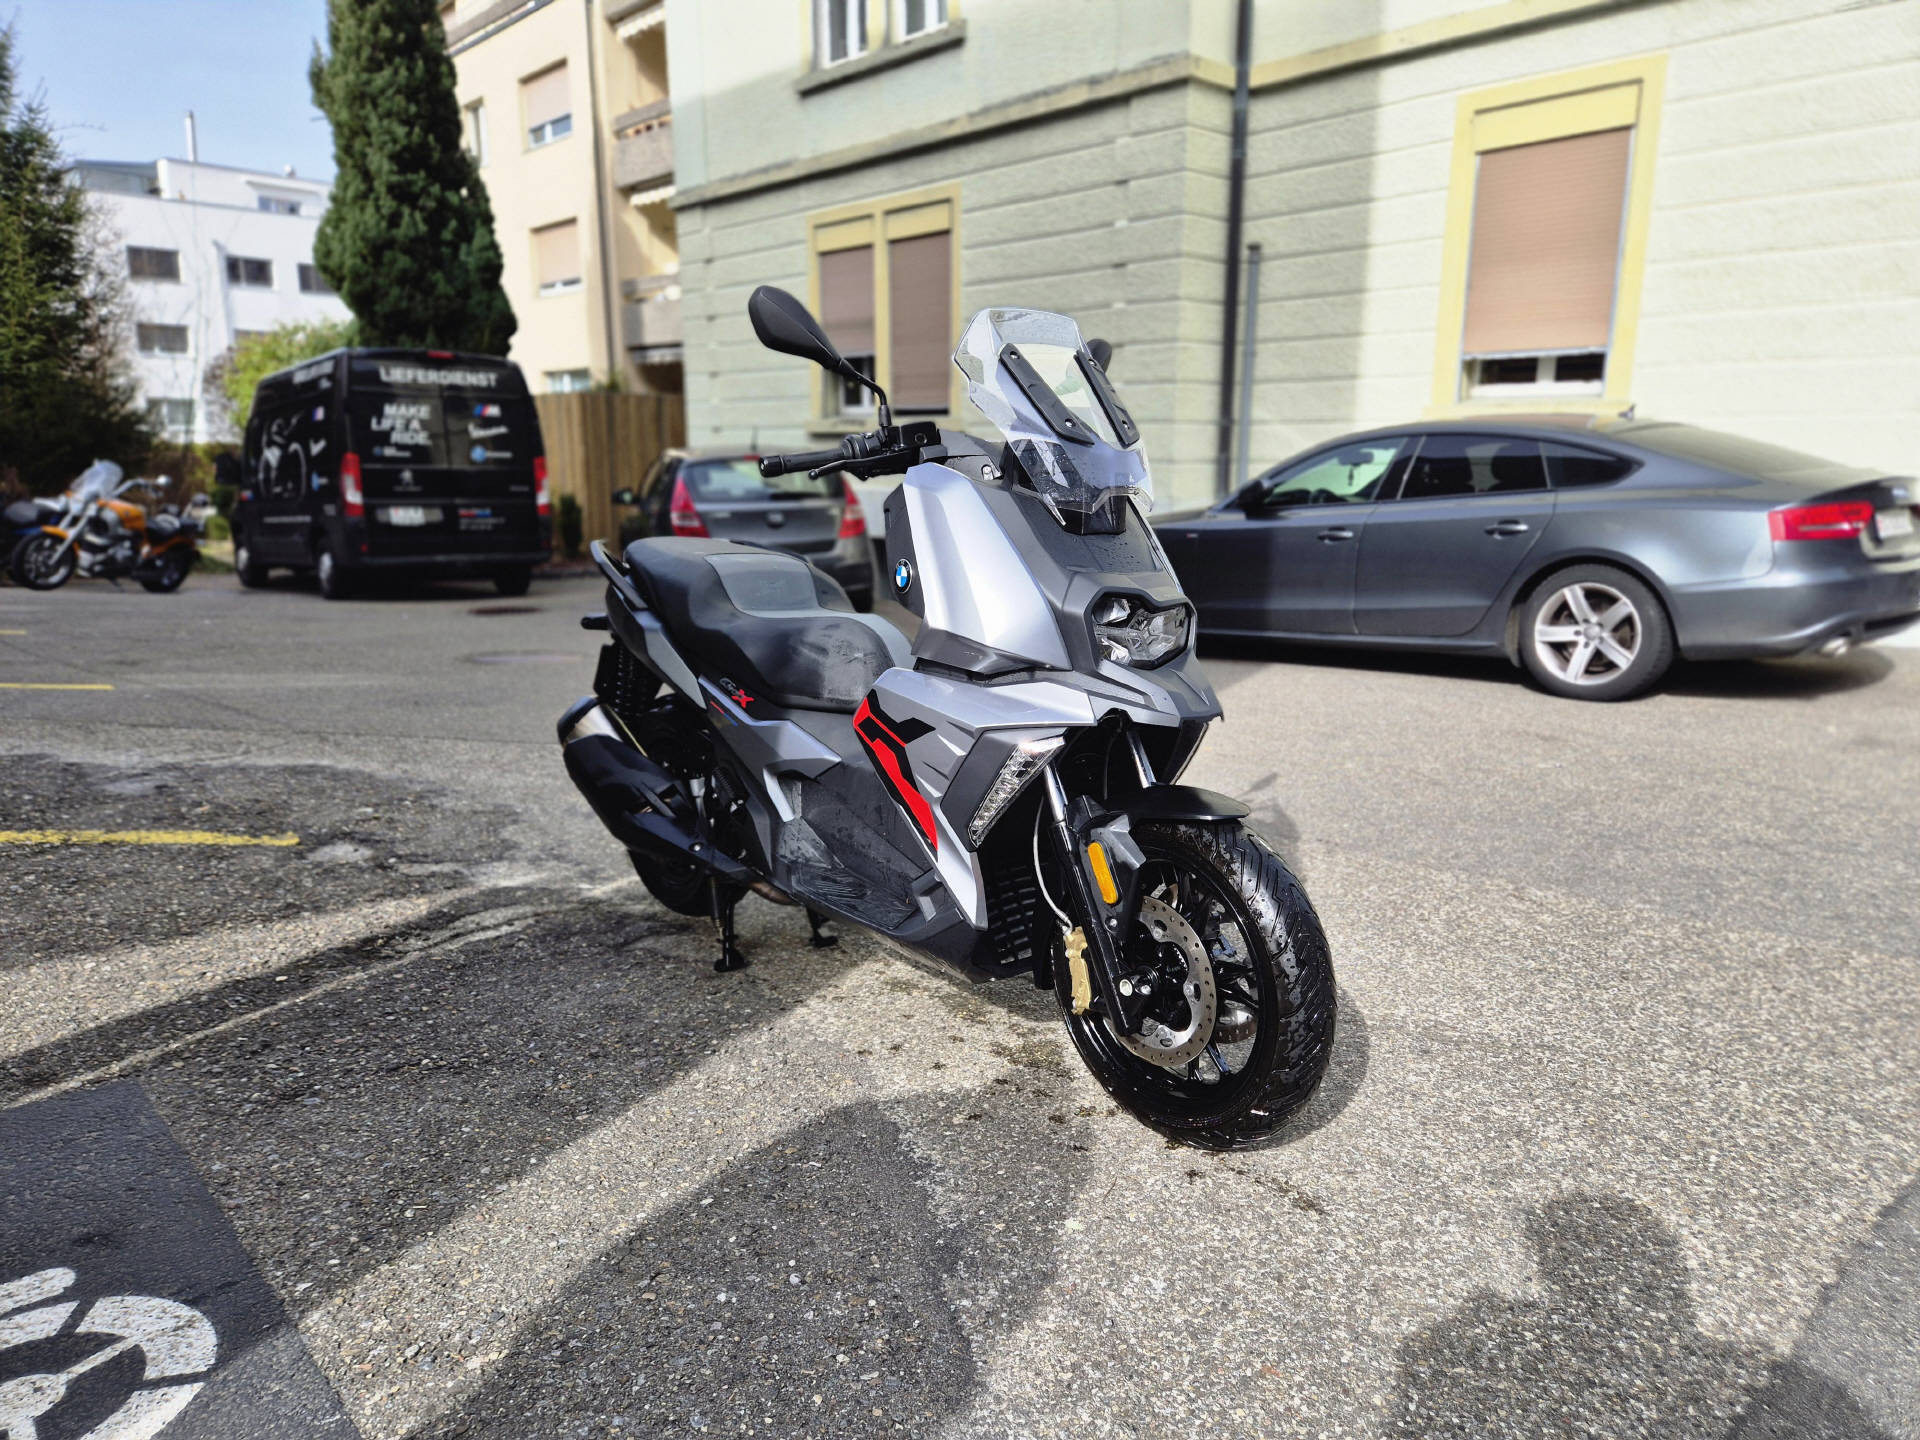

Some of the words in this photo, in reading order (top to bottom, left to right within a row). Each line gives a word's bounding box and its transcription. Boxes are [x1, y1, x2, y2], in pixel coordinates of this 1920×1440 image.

[379, 366, 497, 387] LIEFERDIENST
[384, 403, 430, 419] MAKE
[371, 416, 406, 431] LIFE
[408, 419, 421, 432] A
